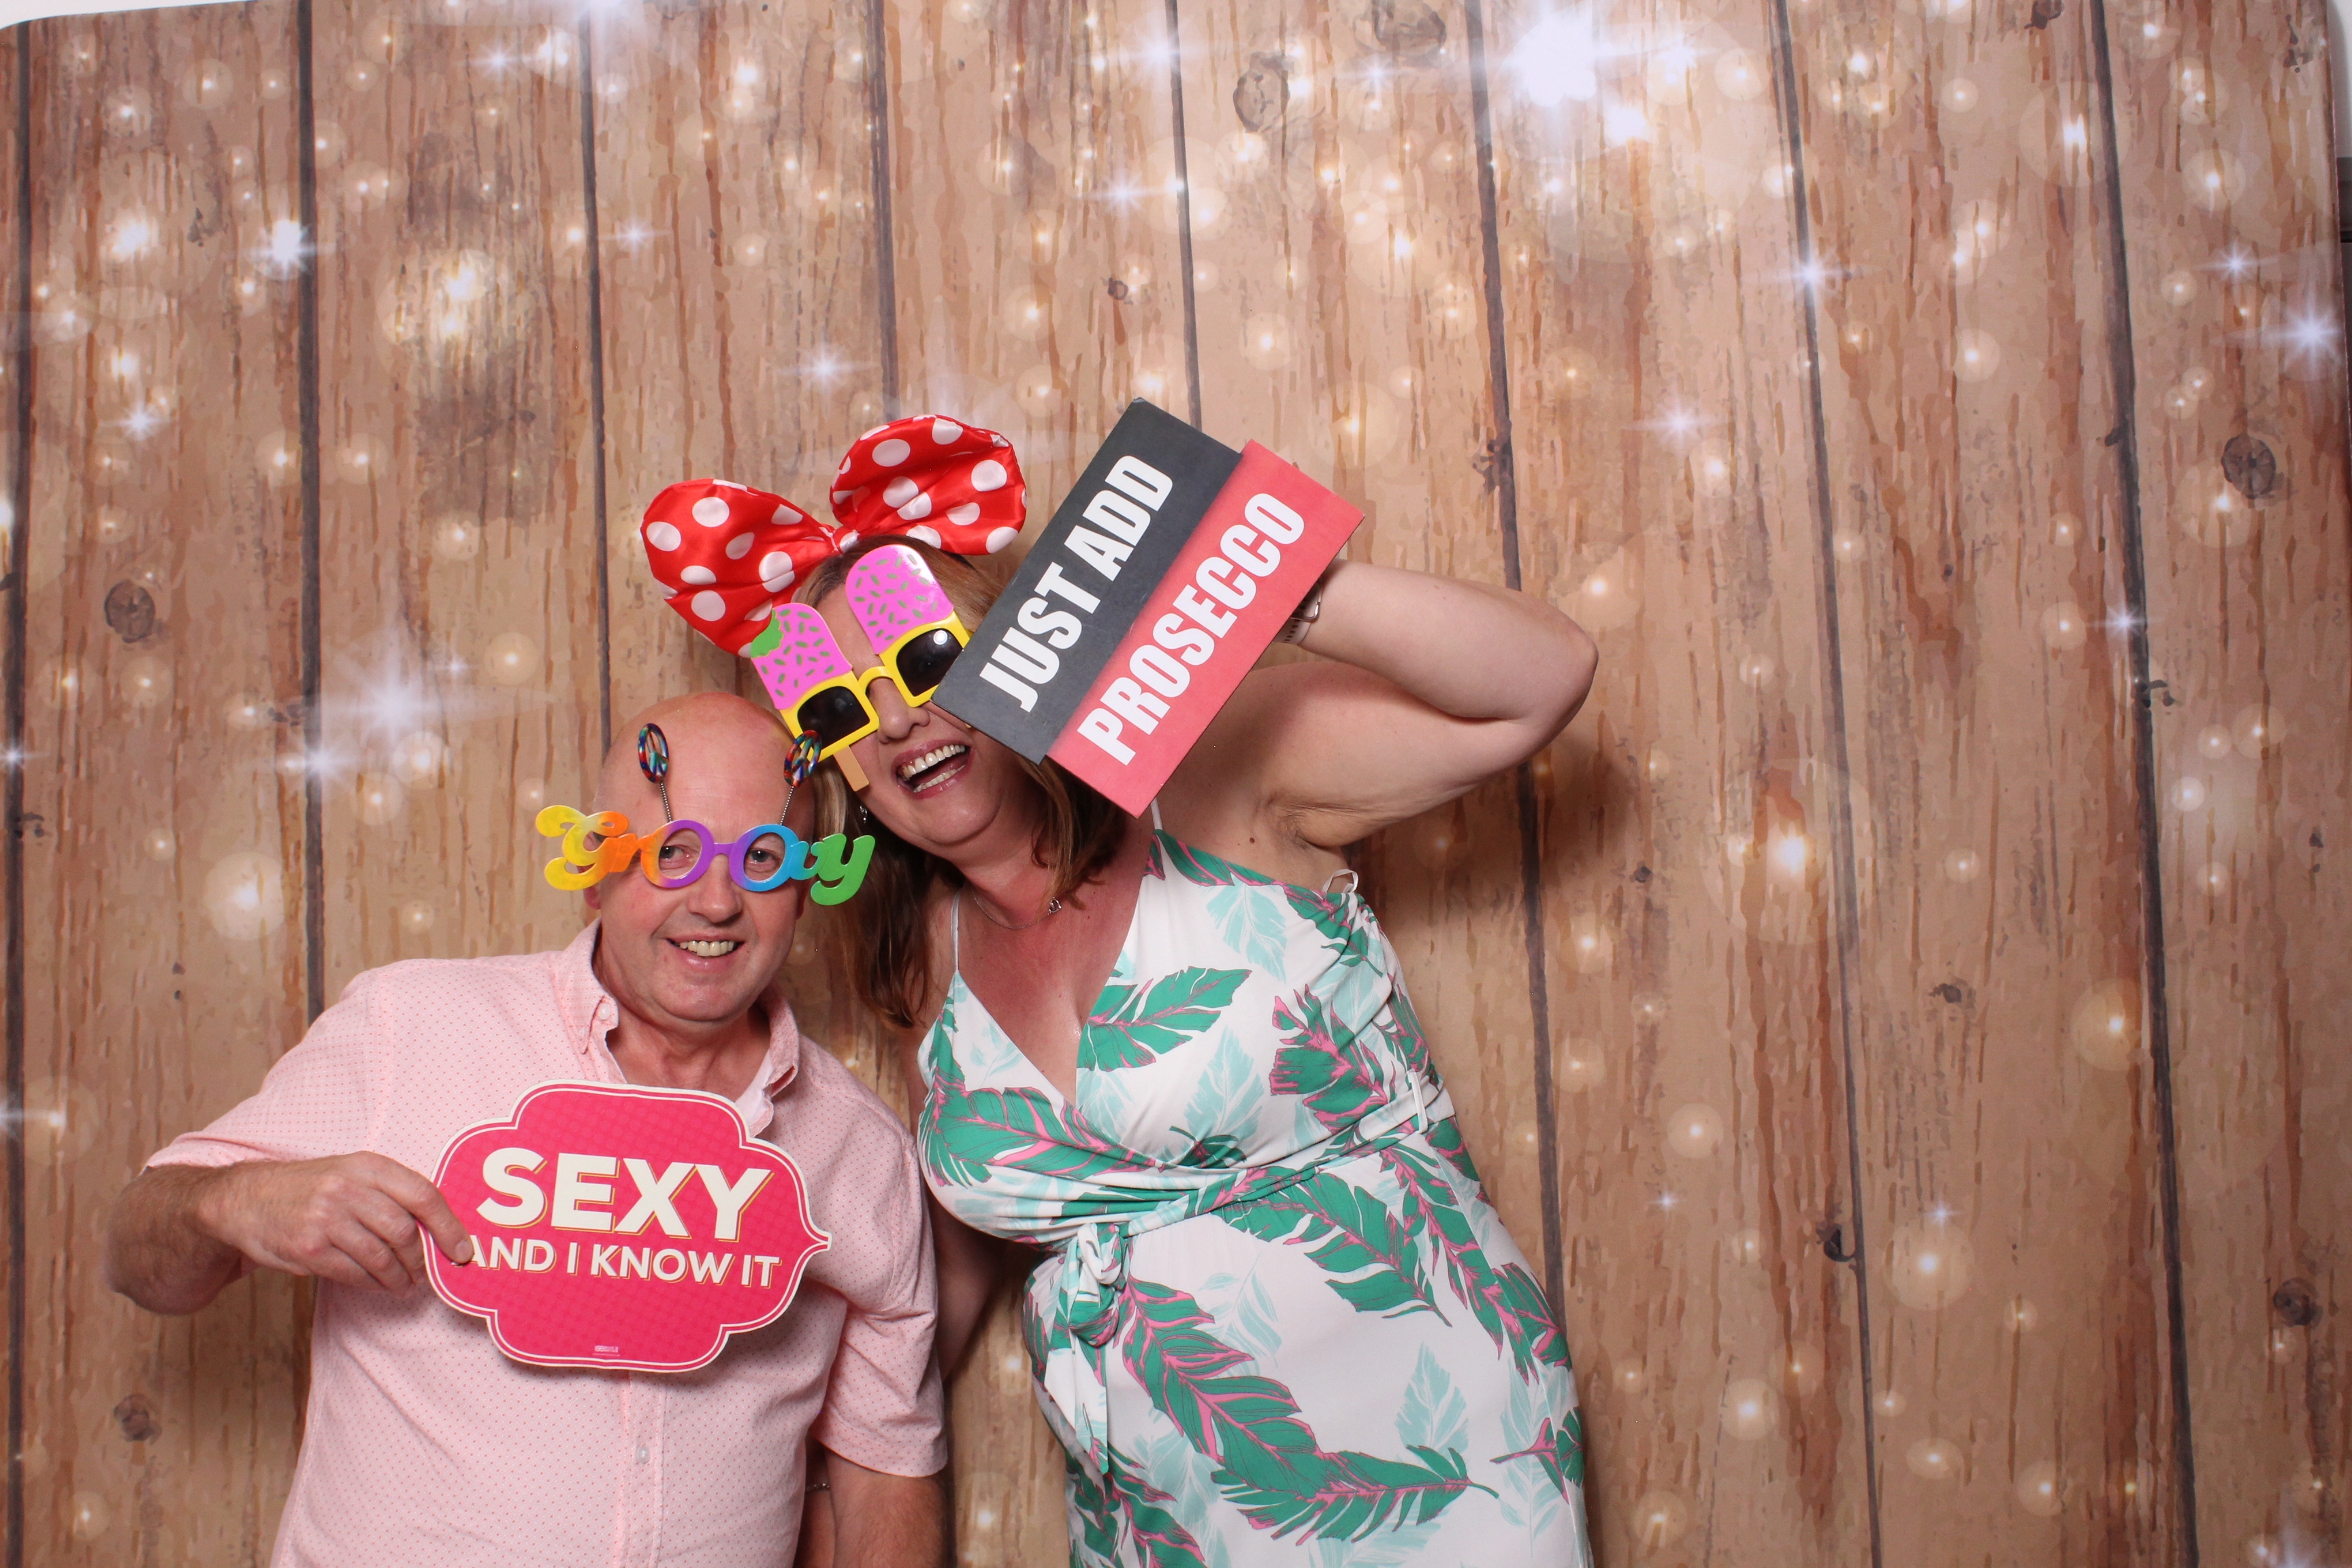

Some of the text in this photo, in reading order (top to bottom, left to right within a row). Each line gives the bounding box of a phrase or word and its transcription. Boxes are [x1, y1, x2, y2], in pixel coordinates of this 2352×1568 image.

[979, 455, 1173, 713] JUST ADD
[1077, 493, 1305, 766] PROSECCO
[476, 1147, 773, 1242] SEXY
[566, 1241, 580, 1275] I
[590, 1243, 736, 1286] KNOW
[741, 1254, 782, 1289] IT
